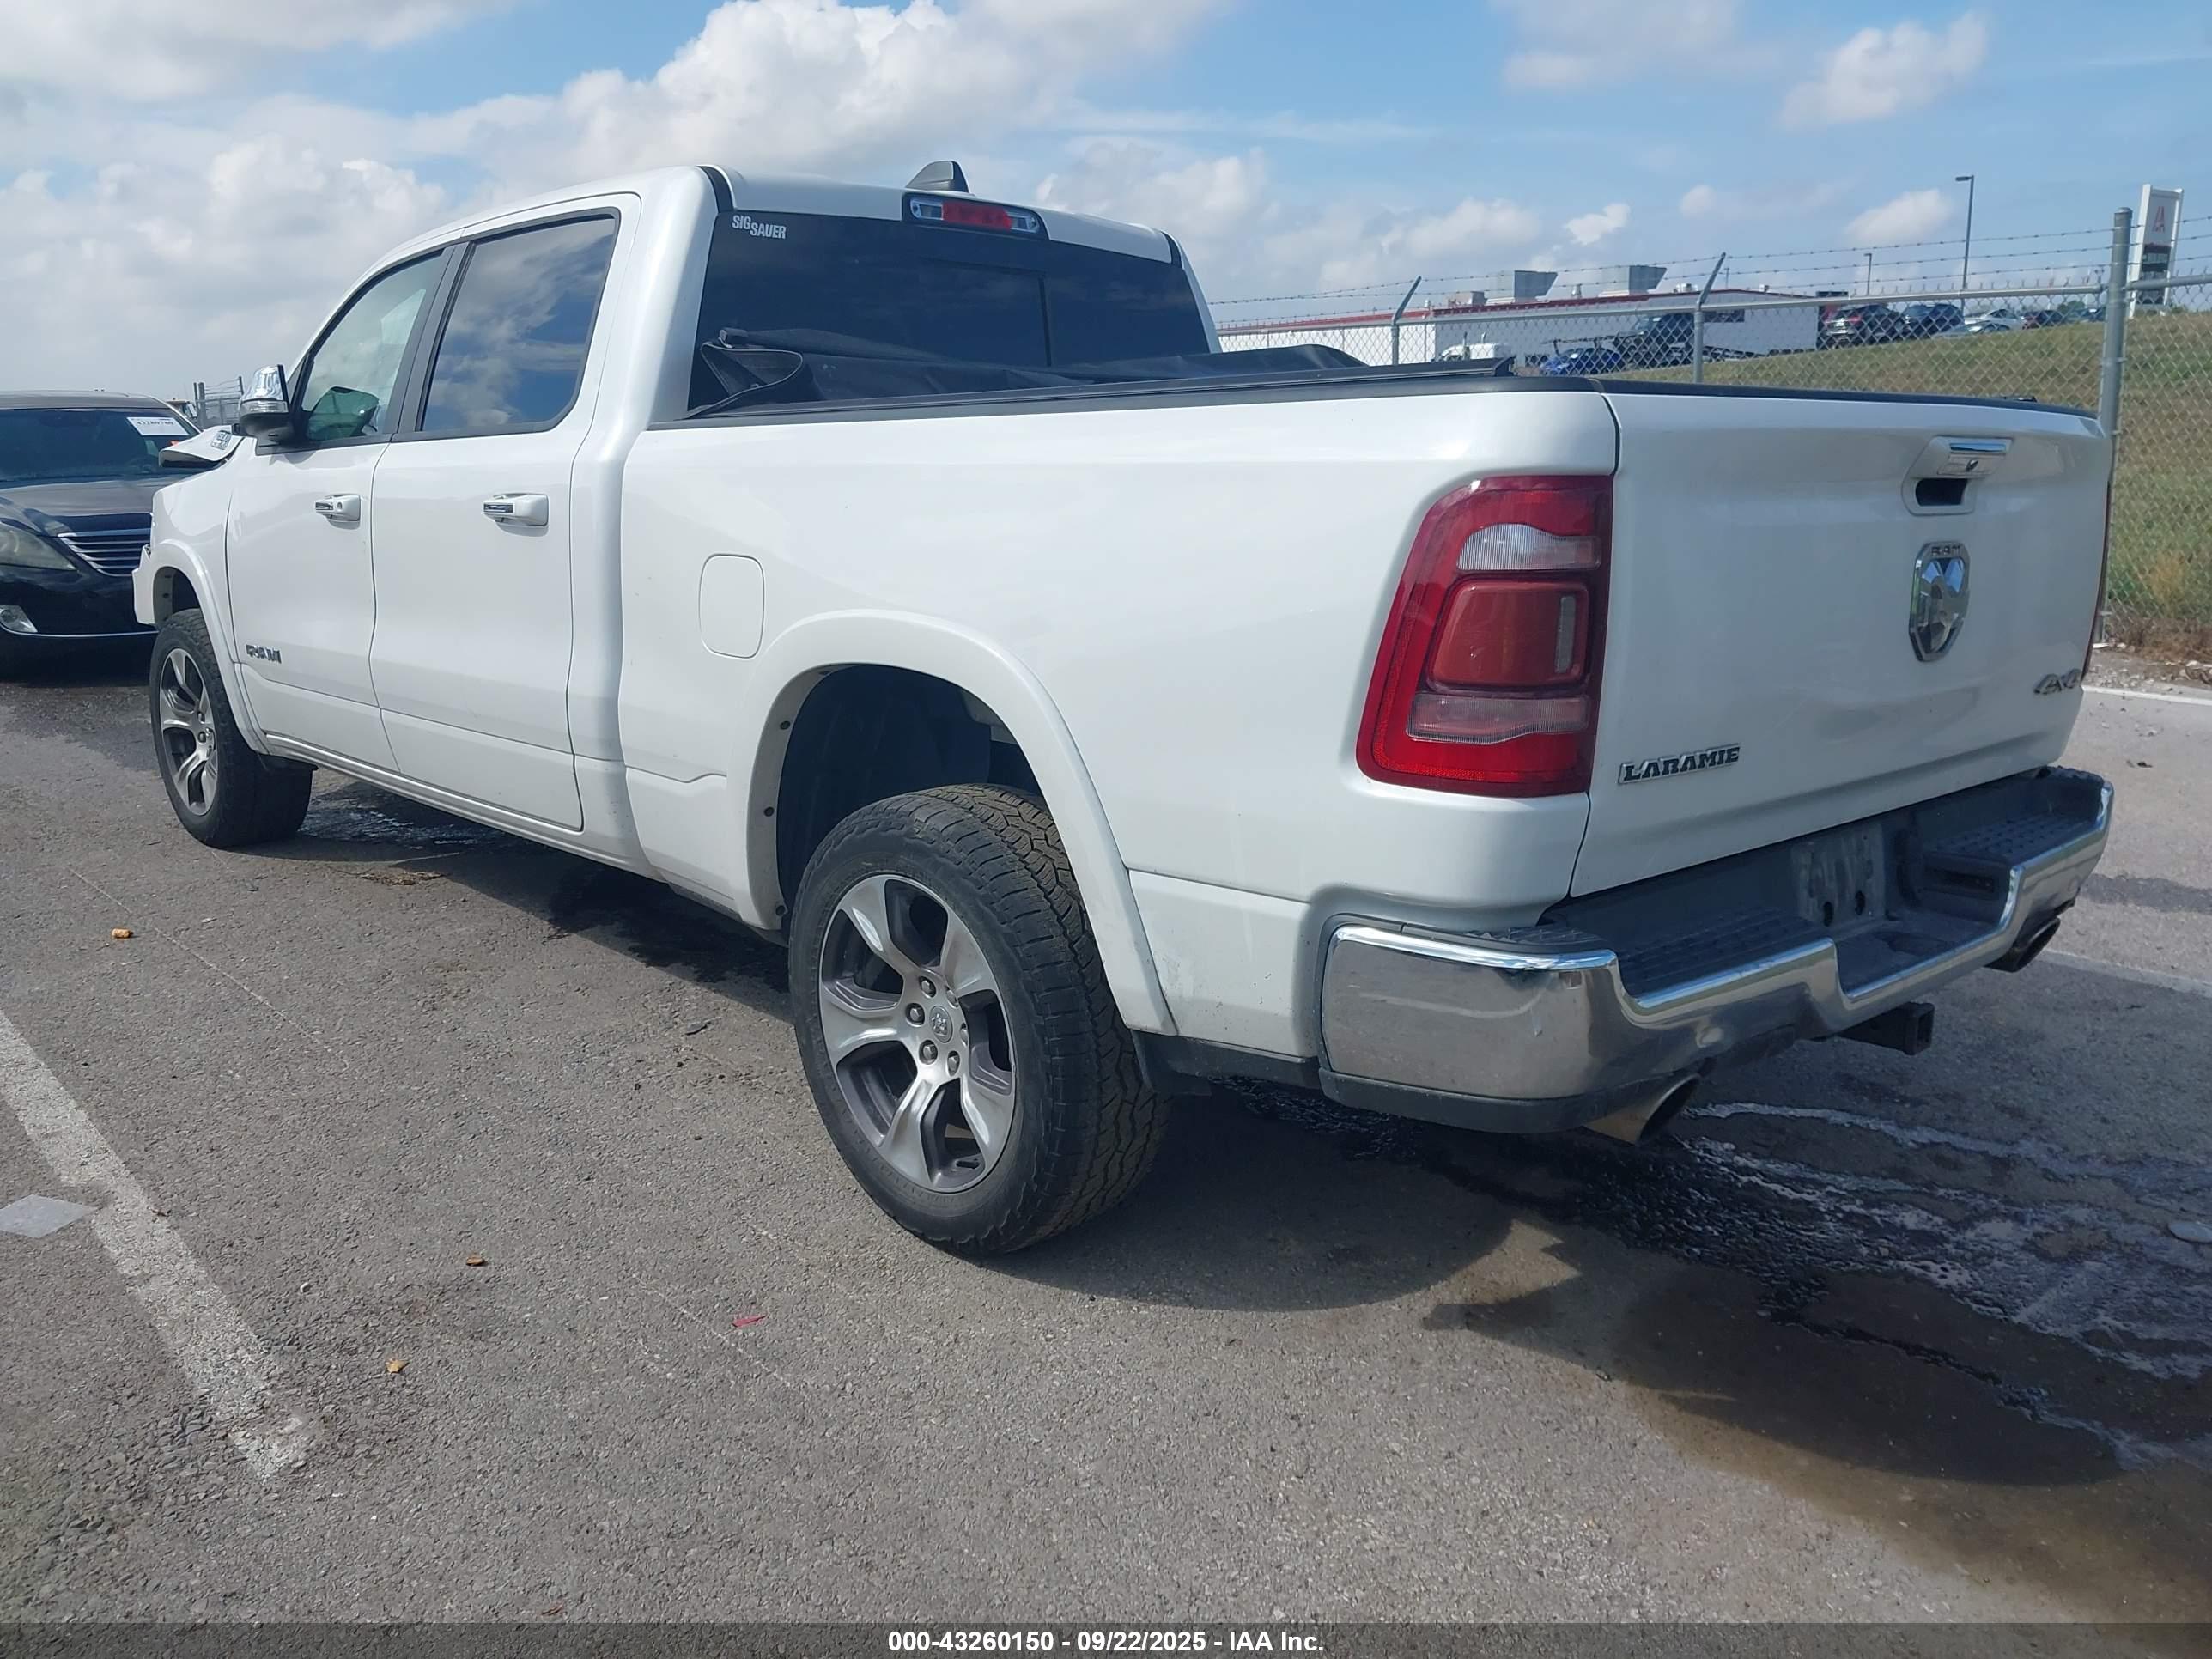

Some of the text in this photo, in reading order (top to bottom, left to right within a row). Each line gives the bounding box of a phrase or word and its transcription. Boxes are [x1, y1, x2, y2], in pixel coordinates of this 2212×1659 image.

[732, 215, 787, 239] SIG SAUER
[1931, 545, 1960, 556] RAM
[1620, 744, 1741, 784] LARAMIE
